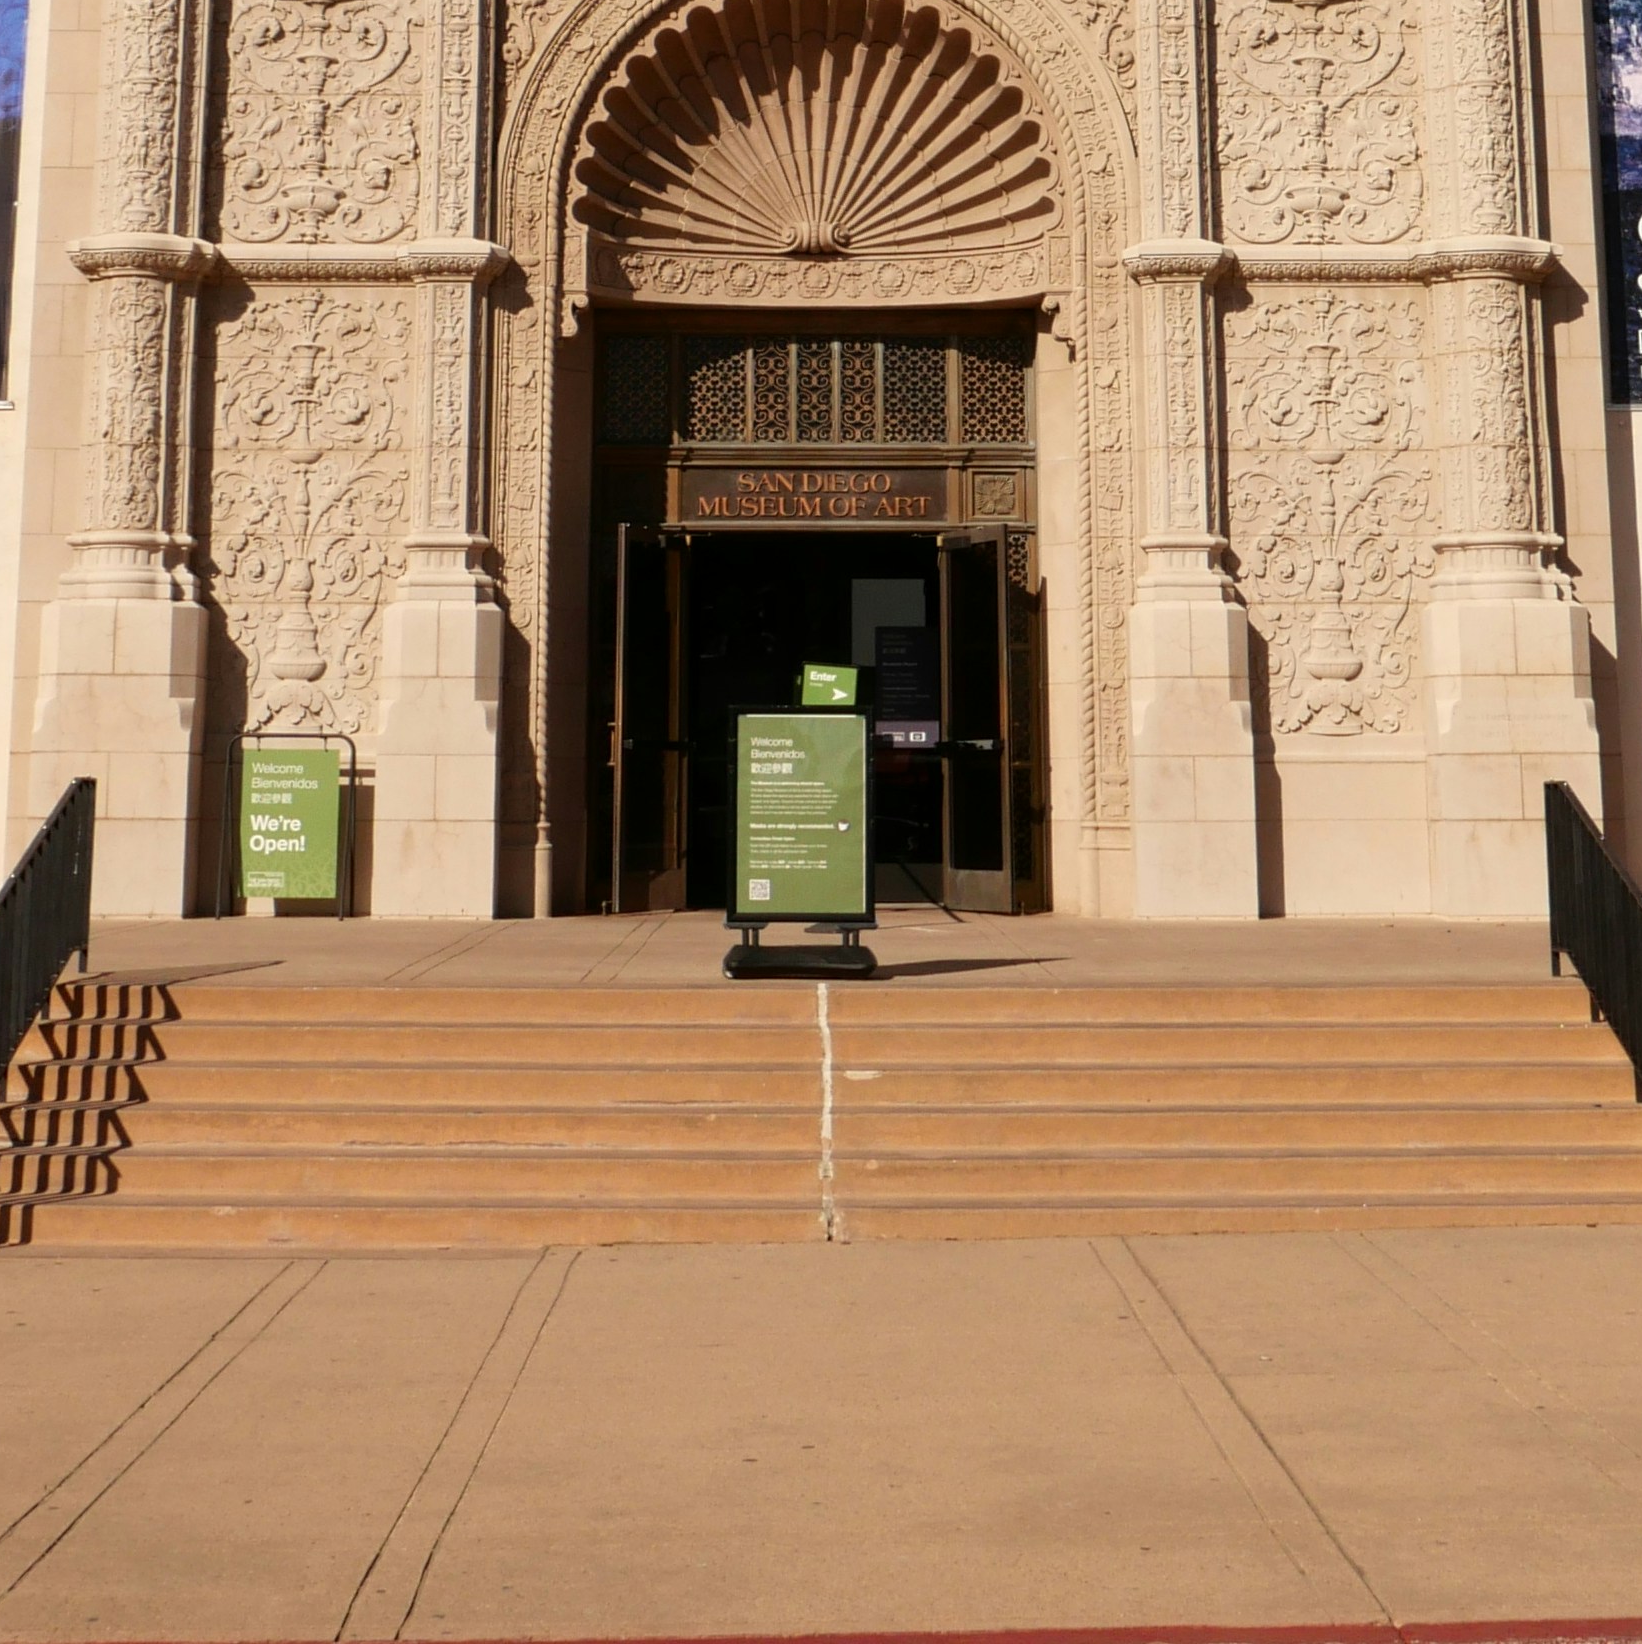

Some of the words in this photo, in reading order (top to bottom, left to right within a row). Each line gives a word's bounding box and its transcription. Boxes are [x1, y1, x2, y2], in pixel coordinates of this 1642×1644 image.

[737, 472, 794, 493] SAN
[801, 472, 891, 493] DIEGO
[697, 496, 823, 517] MUSEUM
[828, 496, 867, 517] OF
[873, 496, 932, 517] ART
[810, 670, 838, 682] Enter
[750, 737, 794, 747] Welcome
[750, 749, 806, 759] Bienvenidos
[251, 762, 304, 774] Welcome
[251, 777, 319, 789] Bienvenidos
[249, 835, 306, 855] Open!
